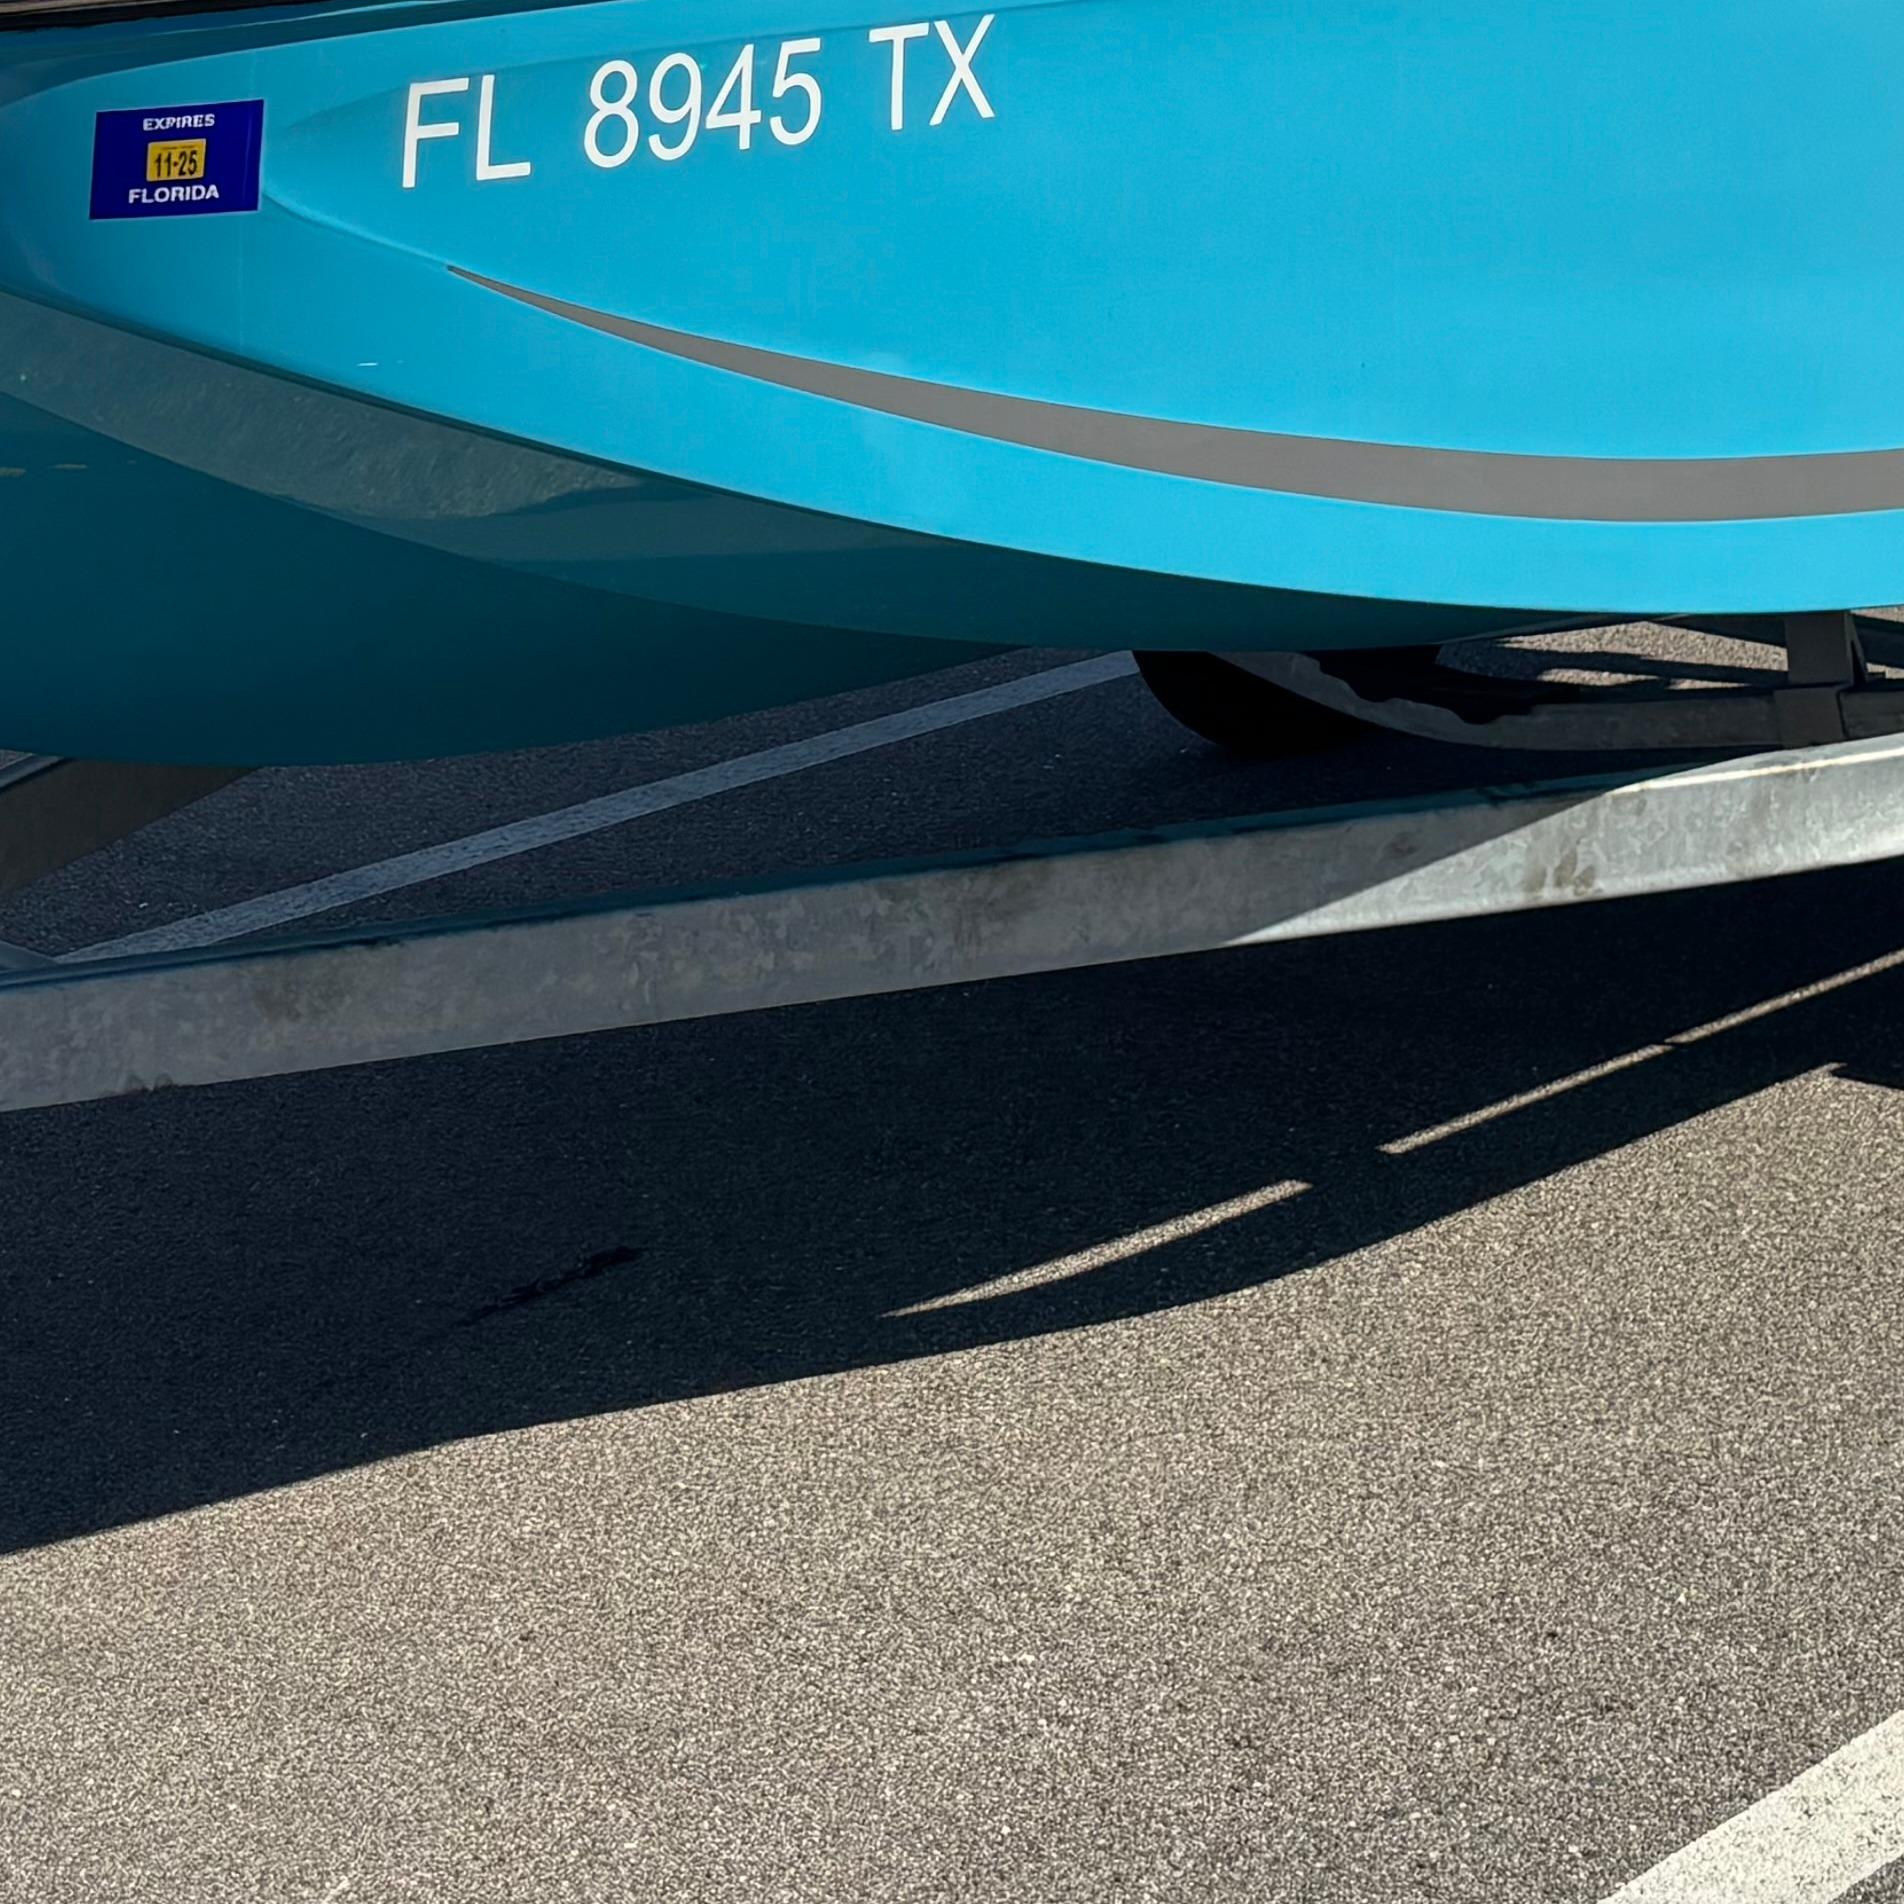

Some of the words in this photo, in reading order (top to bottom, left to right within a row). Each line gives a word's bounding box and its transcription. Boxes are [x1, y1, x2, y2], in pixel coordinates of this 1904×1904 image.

[402, 74, 531, 188] FL
[583, 37, 822, 168] 8945
[868, 13, 996, 131] TX
[142, 113, 215, 131] EXPIRES
[128, 184, 220, 204] FLORIDA
